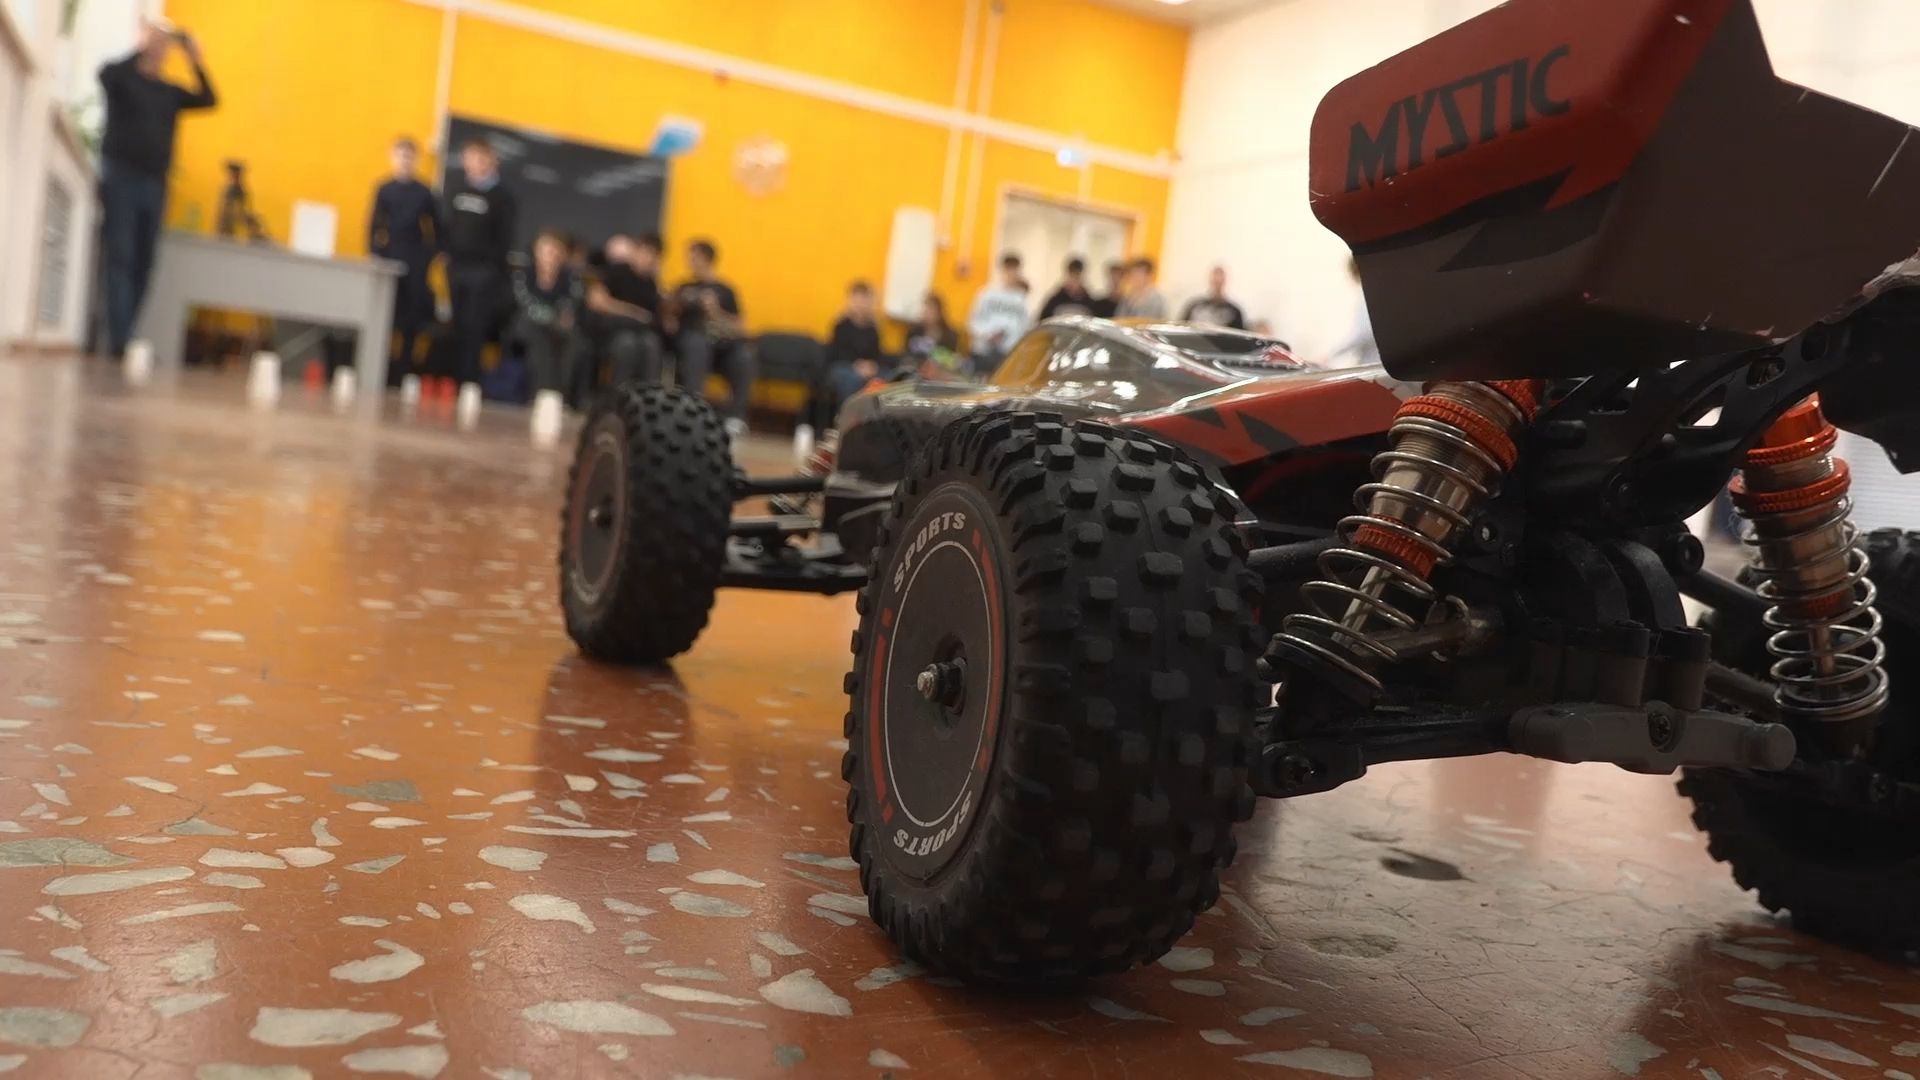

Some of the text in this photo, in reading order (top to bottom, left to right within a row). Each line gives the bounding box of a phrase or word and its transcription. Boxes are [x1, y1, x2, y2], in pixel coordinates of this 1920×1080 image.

[1345, 44, 1571, 193] MYSTIC
[893, 512, 967, 593] SPORTS
[893, 790, 972, 856] SPORTS
